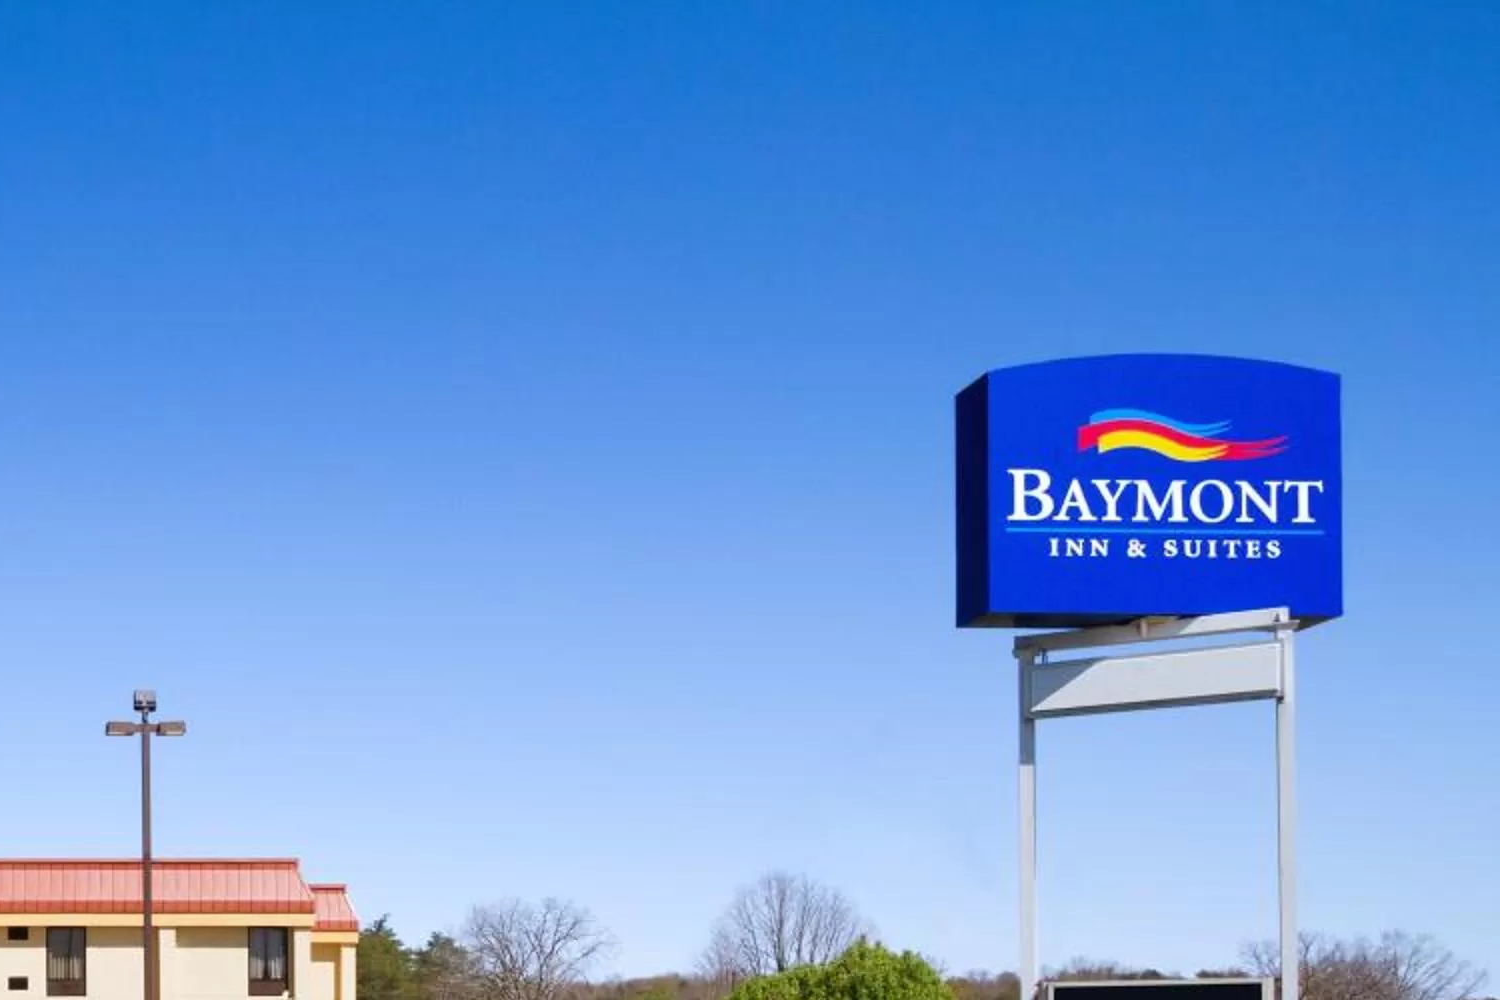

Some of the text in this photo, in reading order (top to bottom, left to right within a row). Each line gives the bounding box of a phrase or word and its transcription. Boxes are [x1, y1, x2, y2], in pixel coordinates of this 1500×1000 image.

[1006, 468, 1324, 524] BAYMONT
[1048, 537, 1283, 560] INN & SUITES
